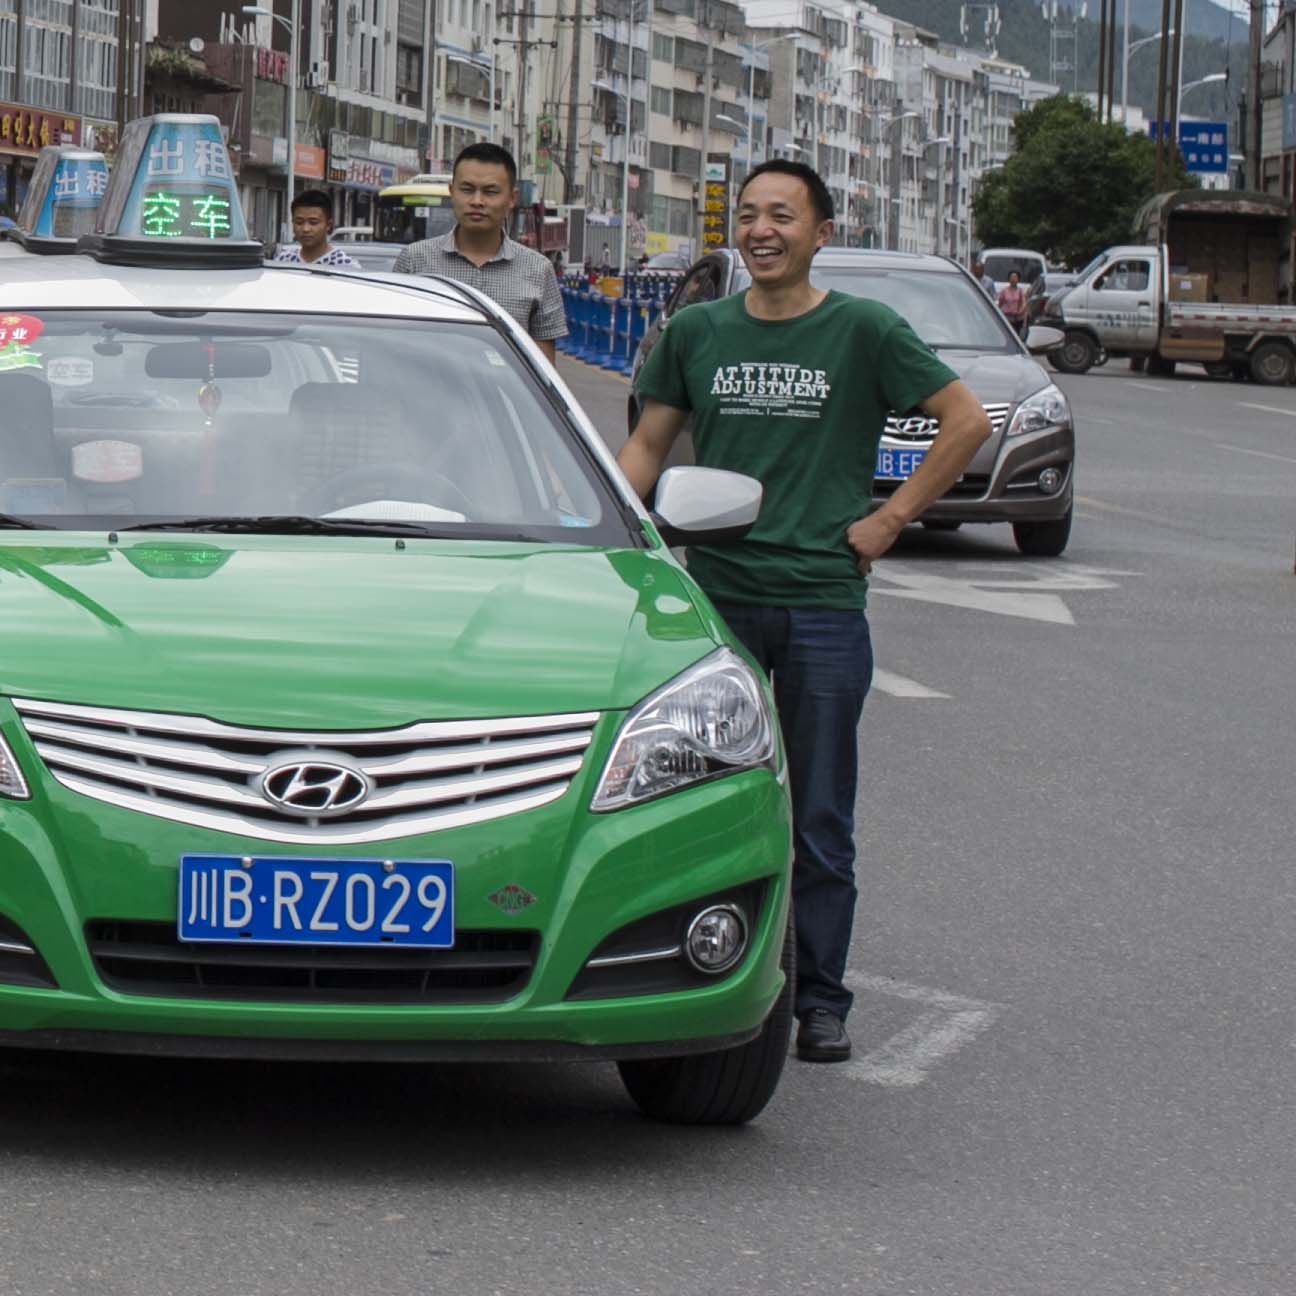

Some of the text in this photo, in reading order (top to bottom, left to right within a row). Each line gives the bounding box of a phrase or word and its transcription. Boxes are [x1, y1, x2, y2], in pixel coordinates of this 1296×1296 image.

[147, 138, 230, 180] 出租
[54, 169, 107, 197] 出租
[143, 192, 231, 239] 空车
[710, 380, 831, 399] ADJUSTMENT
[712, 366, 827, 385] ATTITUDE
[188, 868, 448, 934] 川B·RZ029
